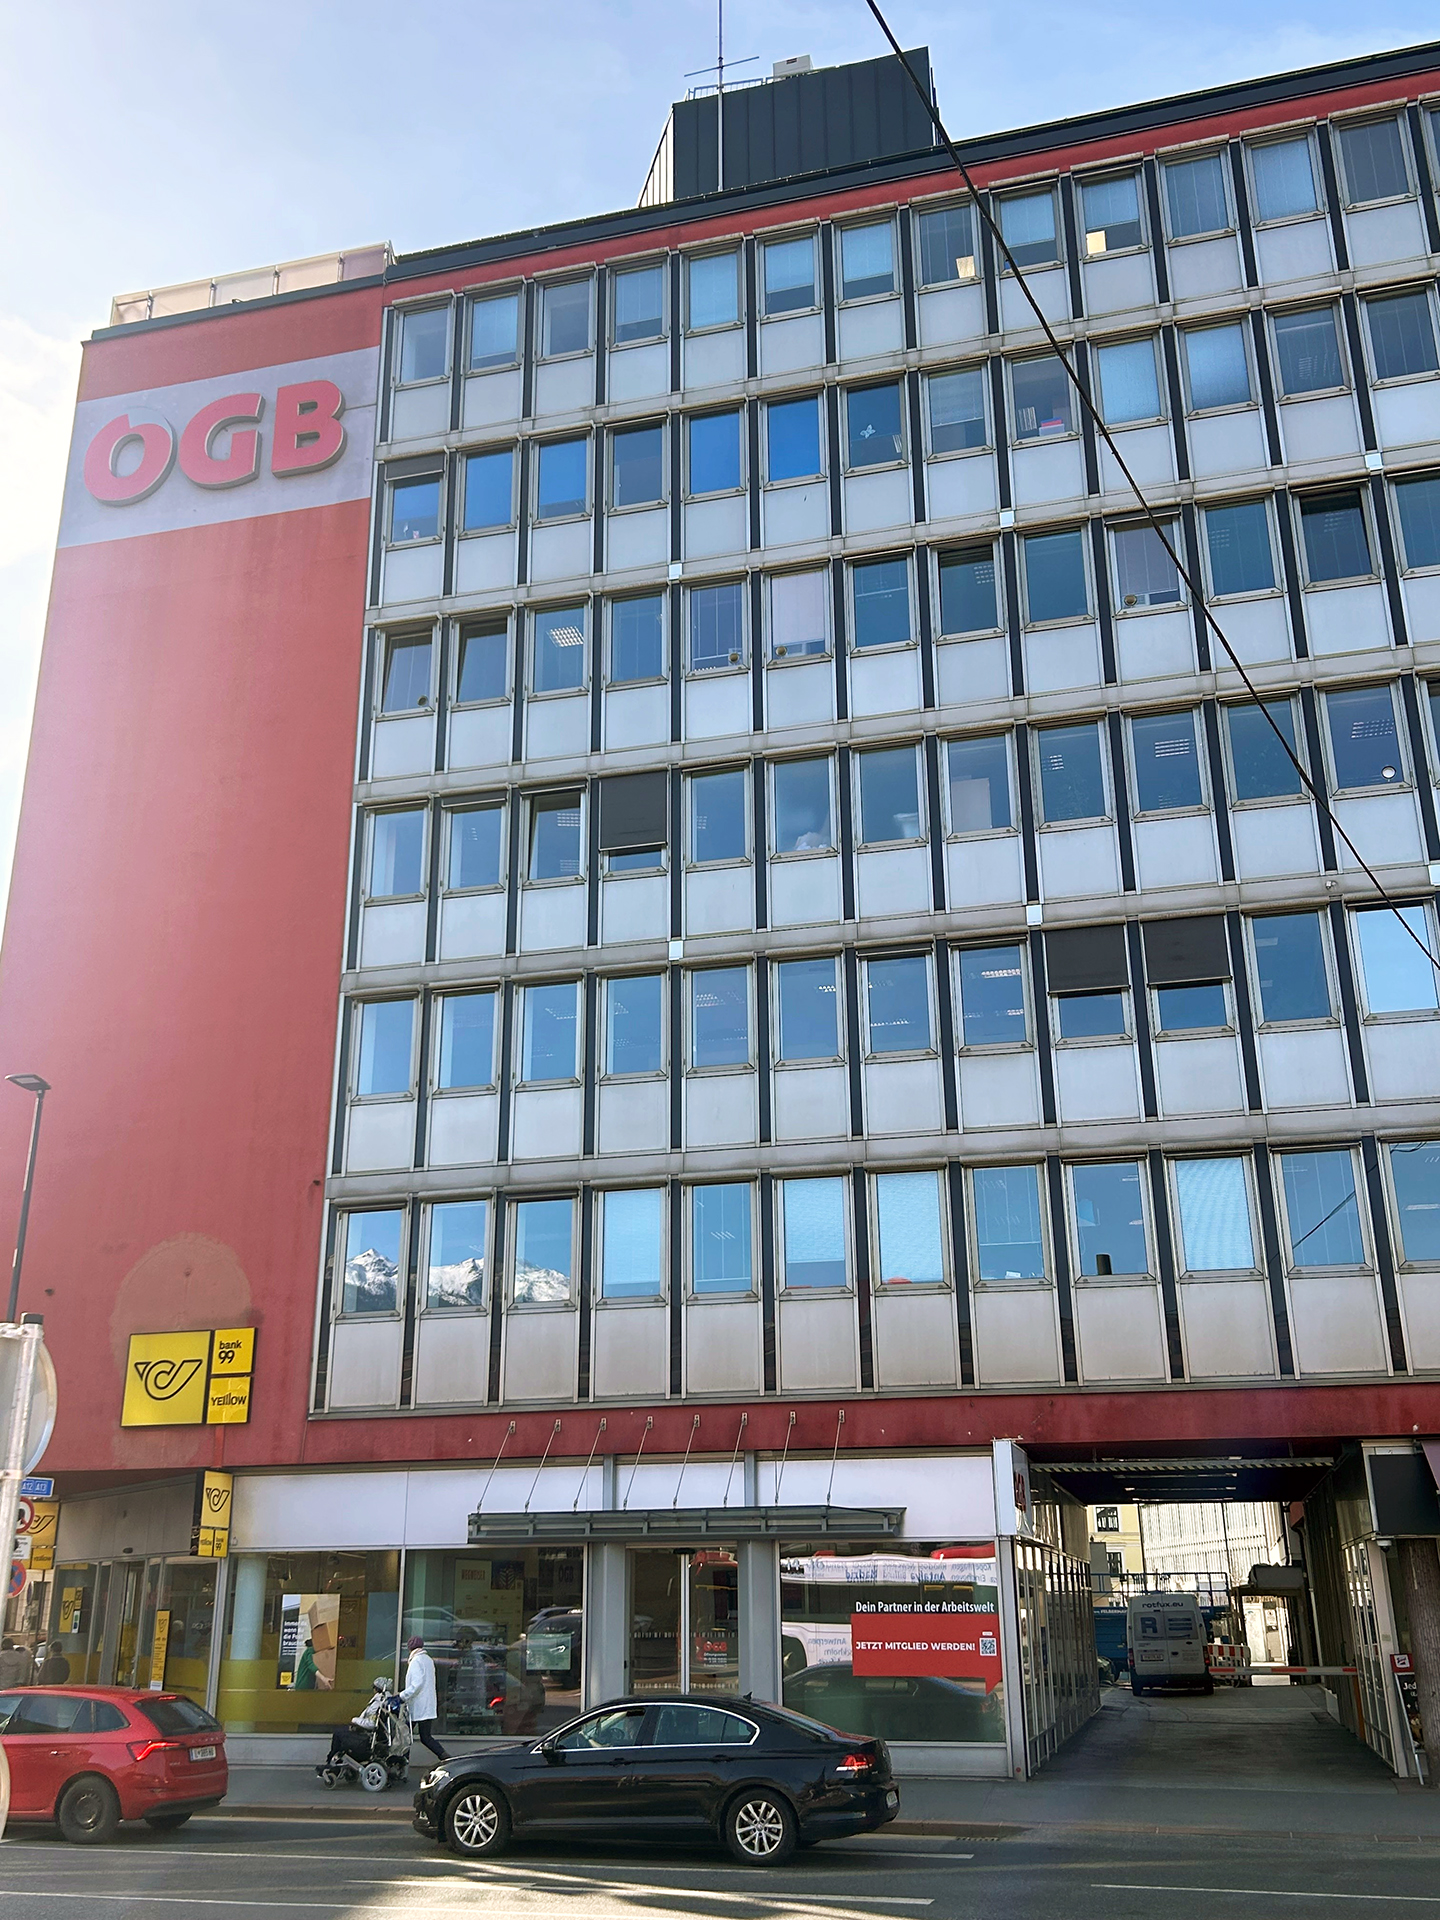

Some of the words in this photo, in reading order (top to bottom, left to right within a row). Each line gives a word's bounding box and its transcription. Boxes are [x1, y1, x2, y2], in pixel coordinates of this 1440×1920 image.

[219, 1340, 242, 1349] bank
[218, 1350, 235, 1364] 99
[21, 1482, 33, 1491] A12
[35, 1483, 47, 1492] A13
[215, 1543, 223, 1552] 99
[855, 1601, 876, 1613] Dein
[878, 1601, 912, 1613] Partner
[913, 1601, 923, 1613] in
[924, 1601, 940, 1613] der
[941, 1601, 995, 1613] Arbeitswelt
[855, 1641, 883, 1651] JETZT
[885, 1641, 928, 1651] MITGLIED
[930, 1642, 976, 1651] WERDEN!
[1402, 1682, 1417, 1690] Jed
